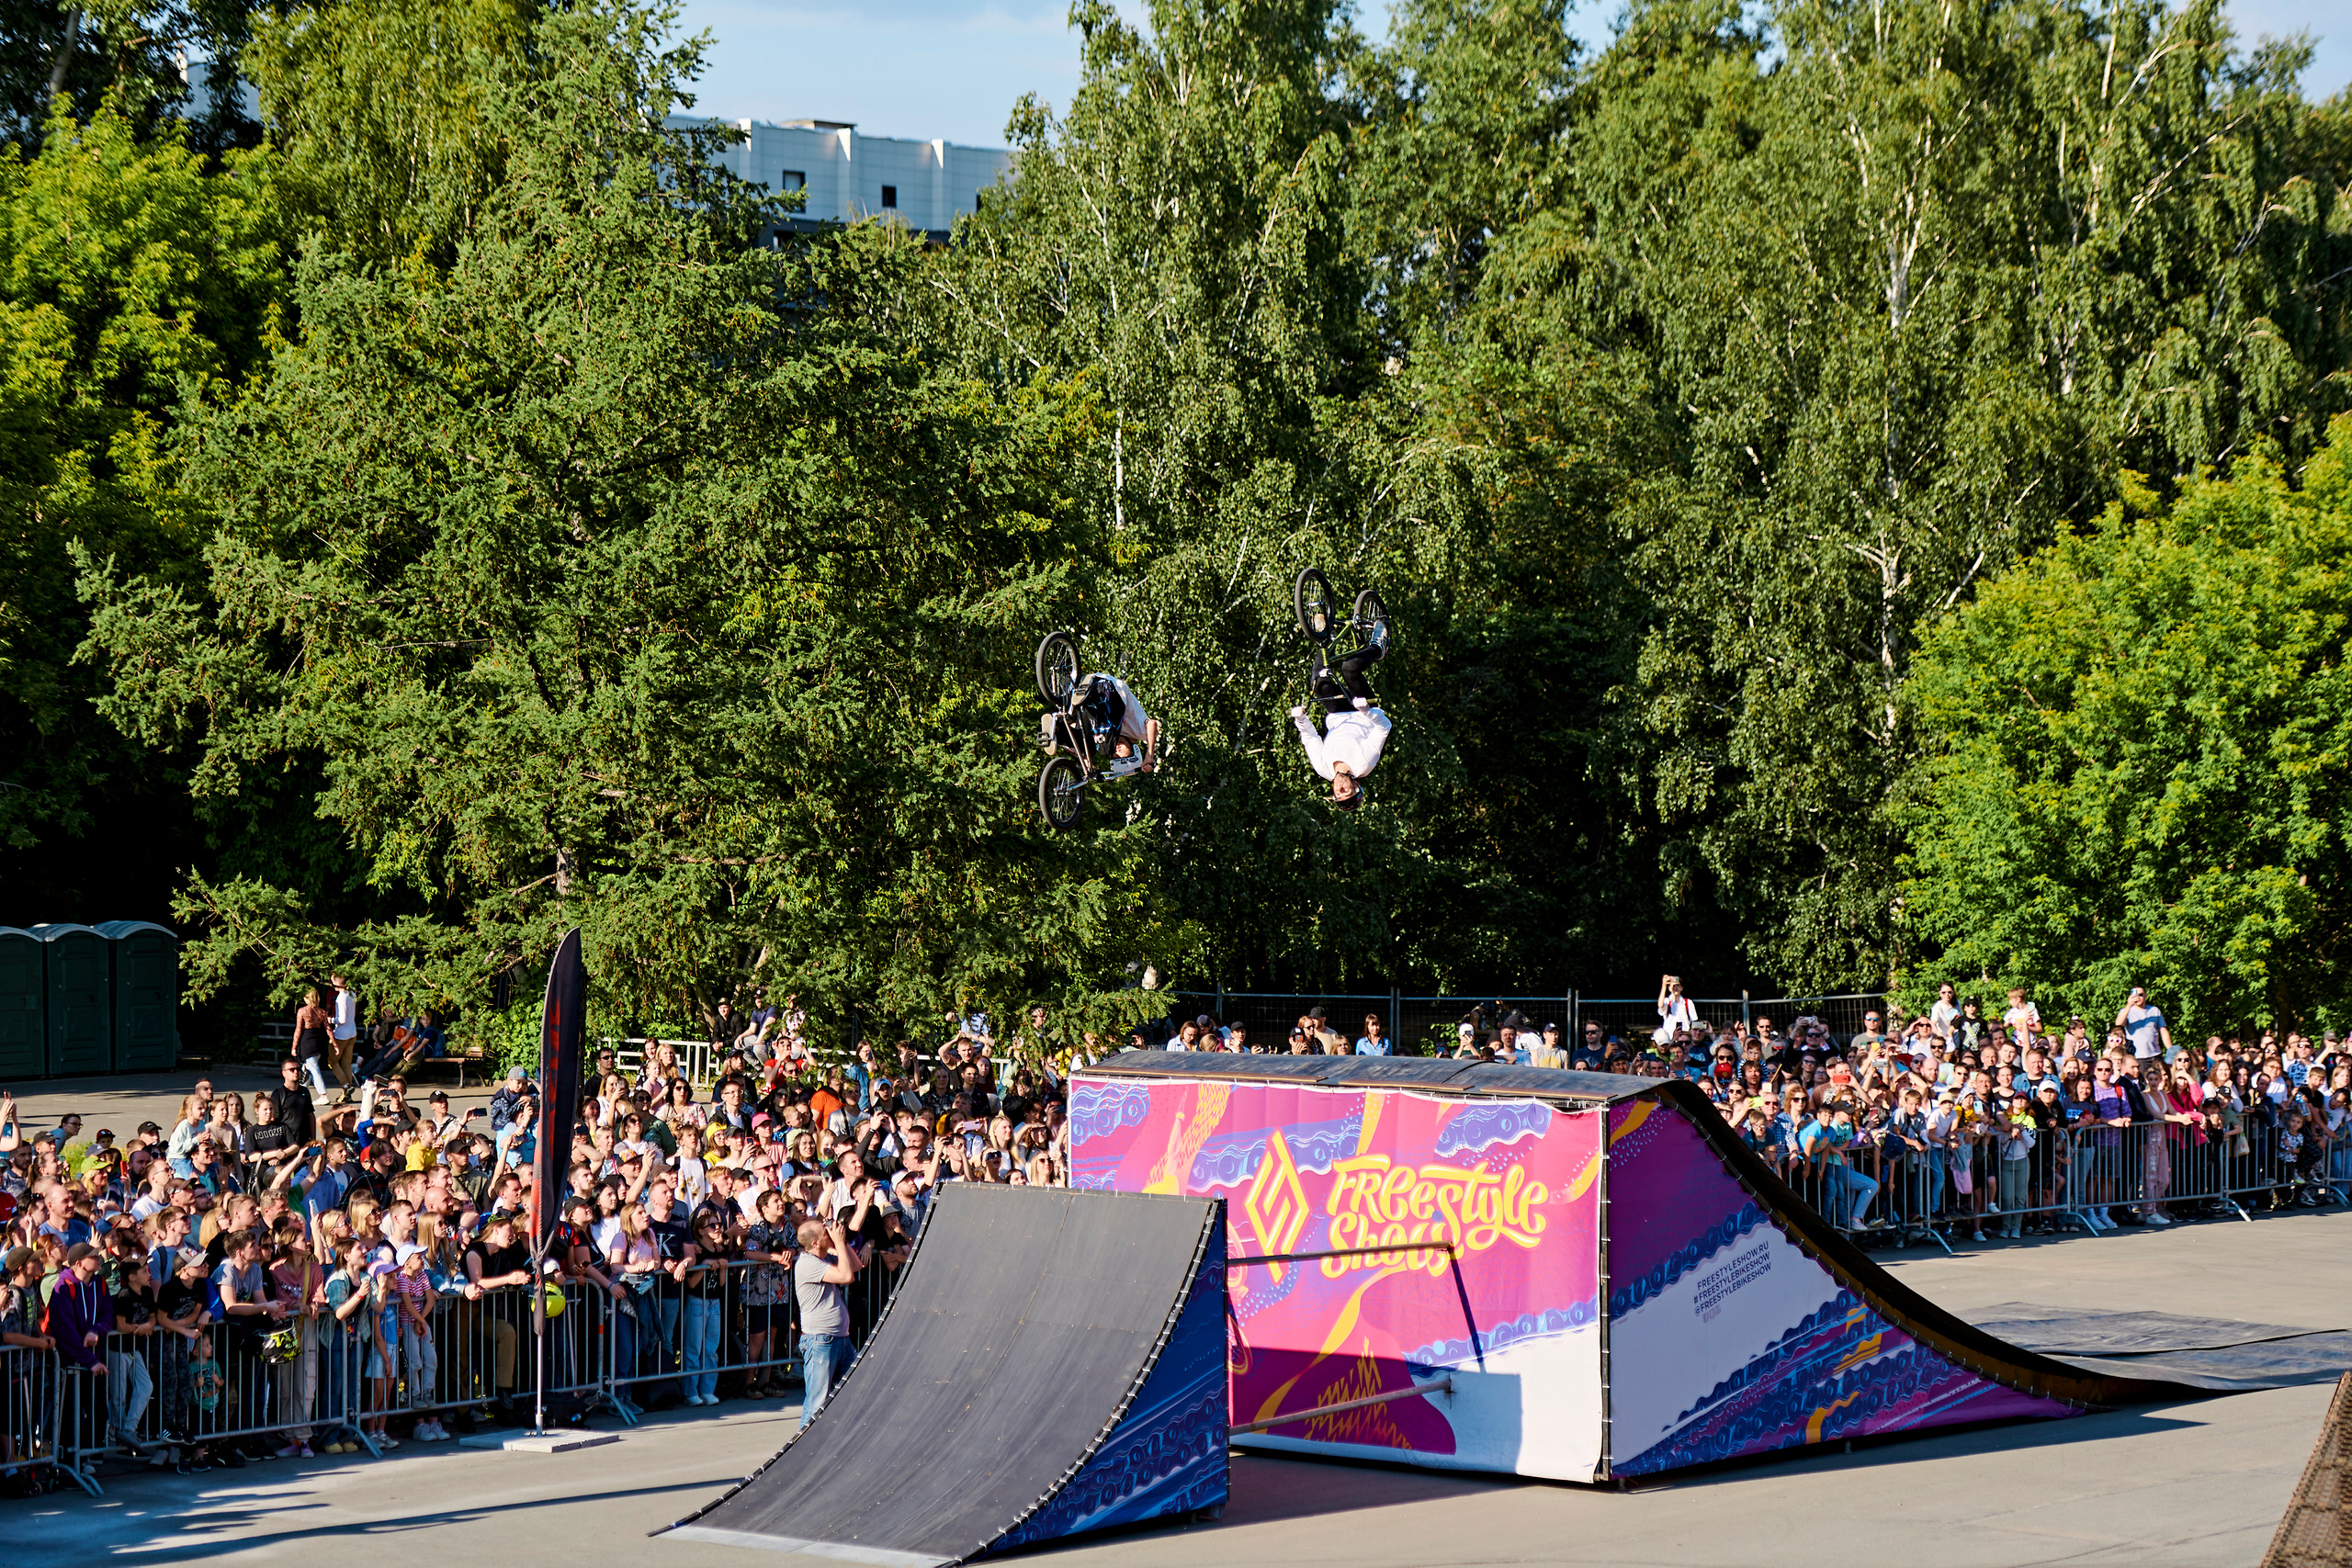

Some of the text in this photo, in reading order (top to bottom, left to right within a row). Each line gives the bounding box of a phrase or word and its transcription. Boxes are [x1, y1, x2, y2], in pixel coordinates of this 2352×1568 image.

[1693, 1251, 1770, 1304] #FREESTYLEBIKESHOW
[1694, 1261, 1772, 1316] @FREESTYLEBIKESHOW
[1697, 1240, 1770, 1291] FREESTYLESHOW.RU
